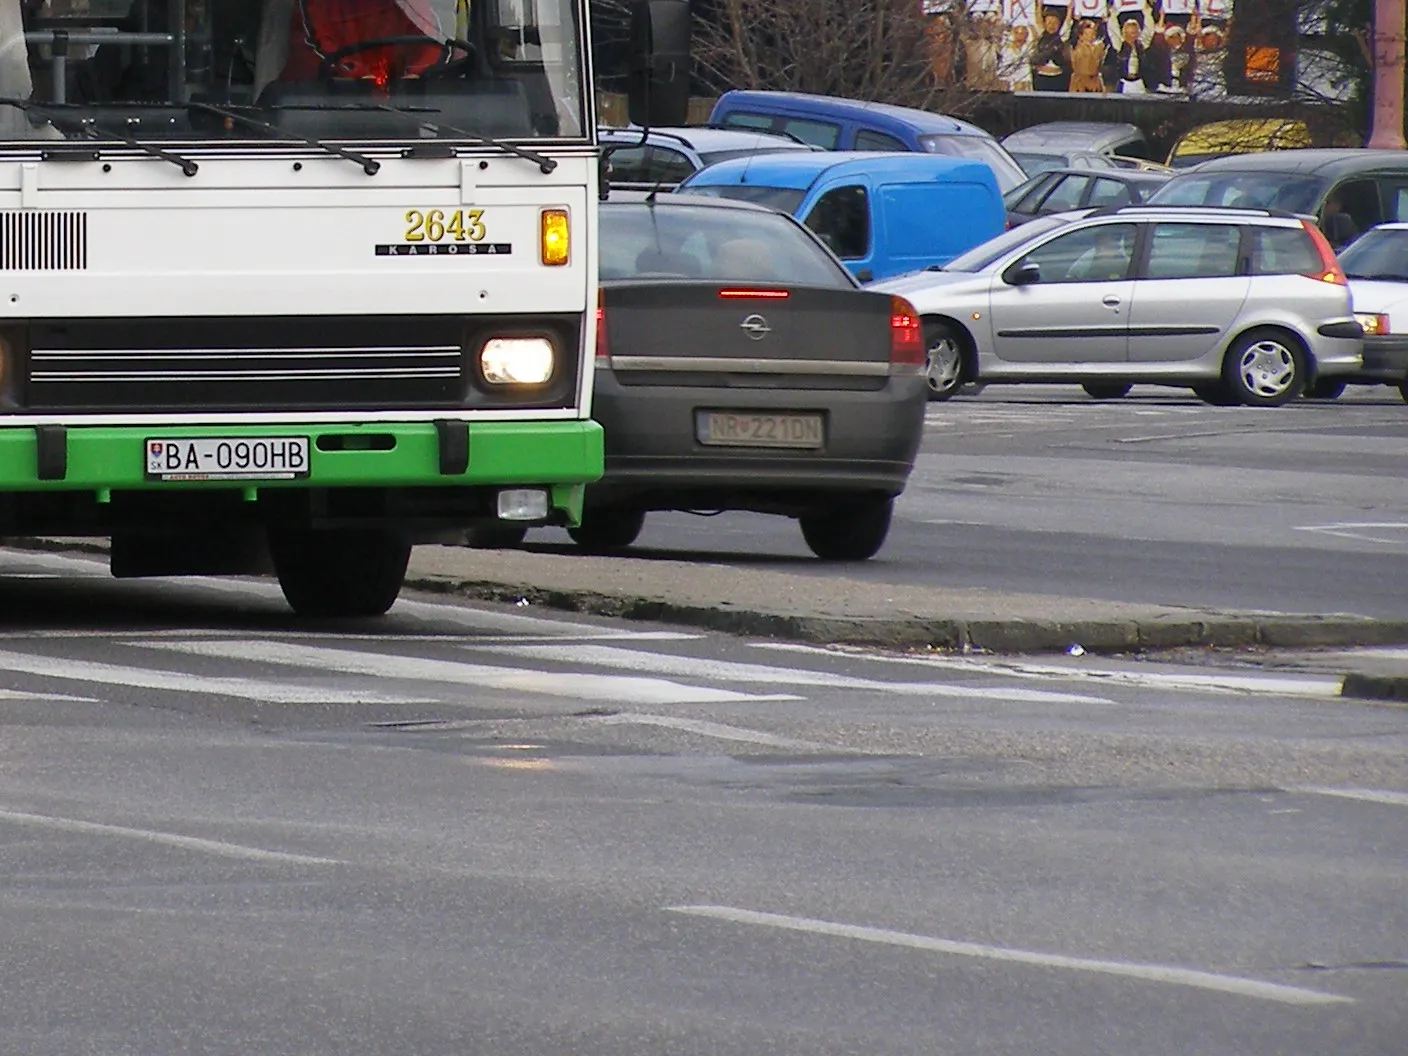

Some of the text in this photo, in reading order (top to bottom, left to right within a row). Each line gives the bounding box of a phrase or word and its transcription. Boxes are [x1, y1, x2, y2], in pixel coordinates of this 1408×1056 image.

[405, 208, 487, 242] 2643
[388, 245, 497, 255] KAROSA
[165, 441, 304, 470] BA-090HB
[151, 461, 163, 471] SK
